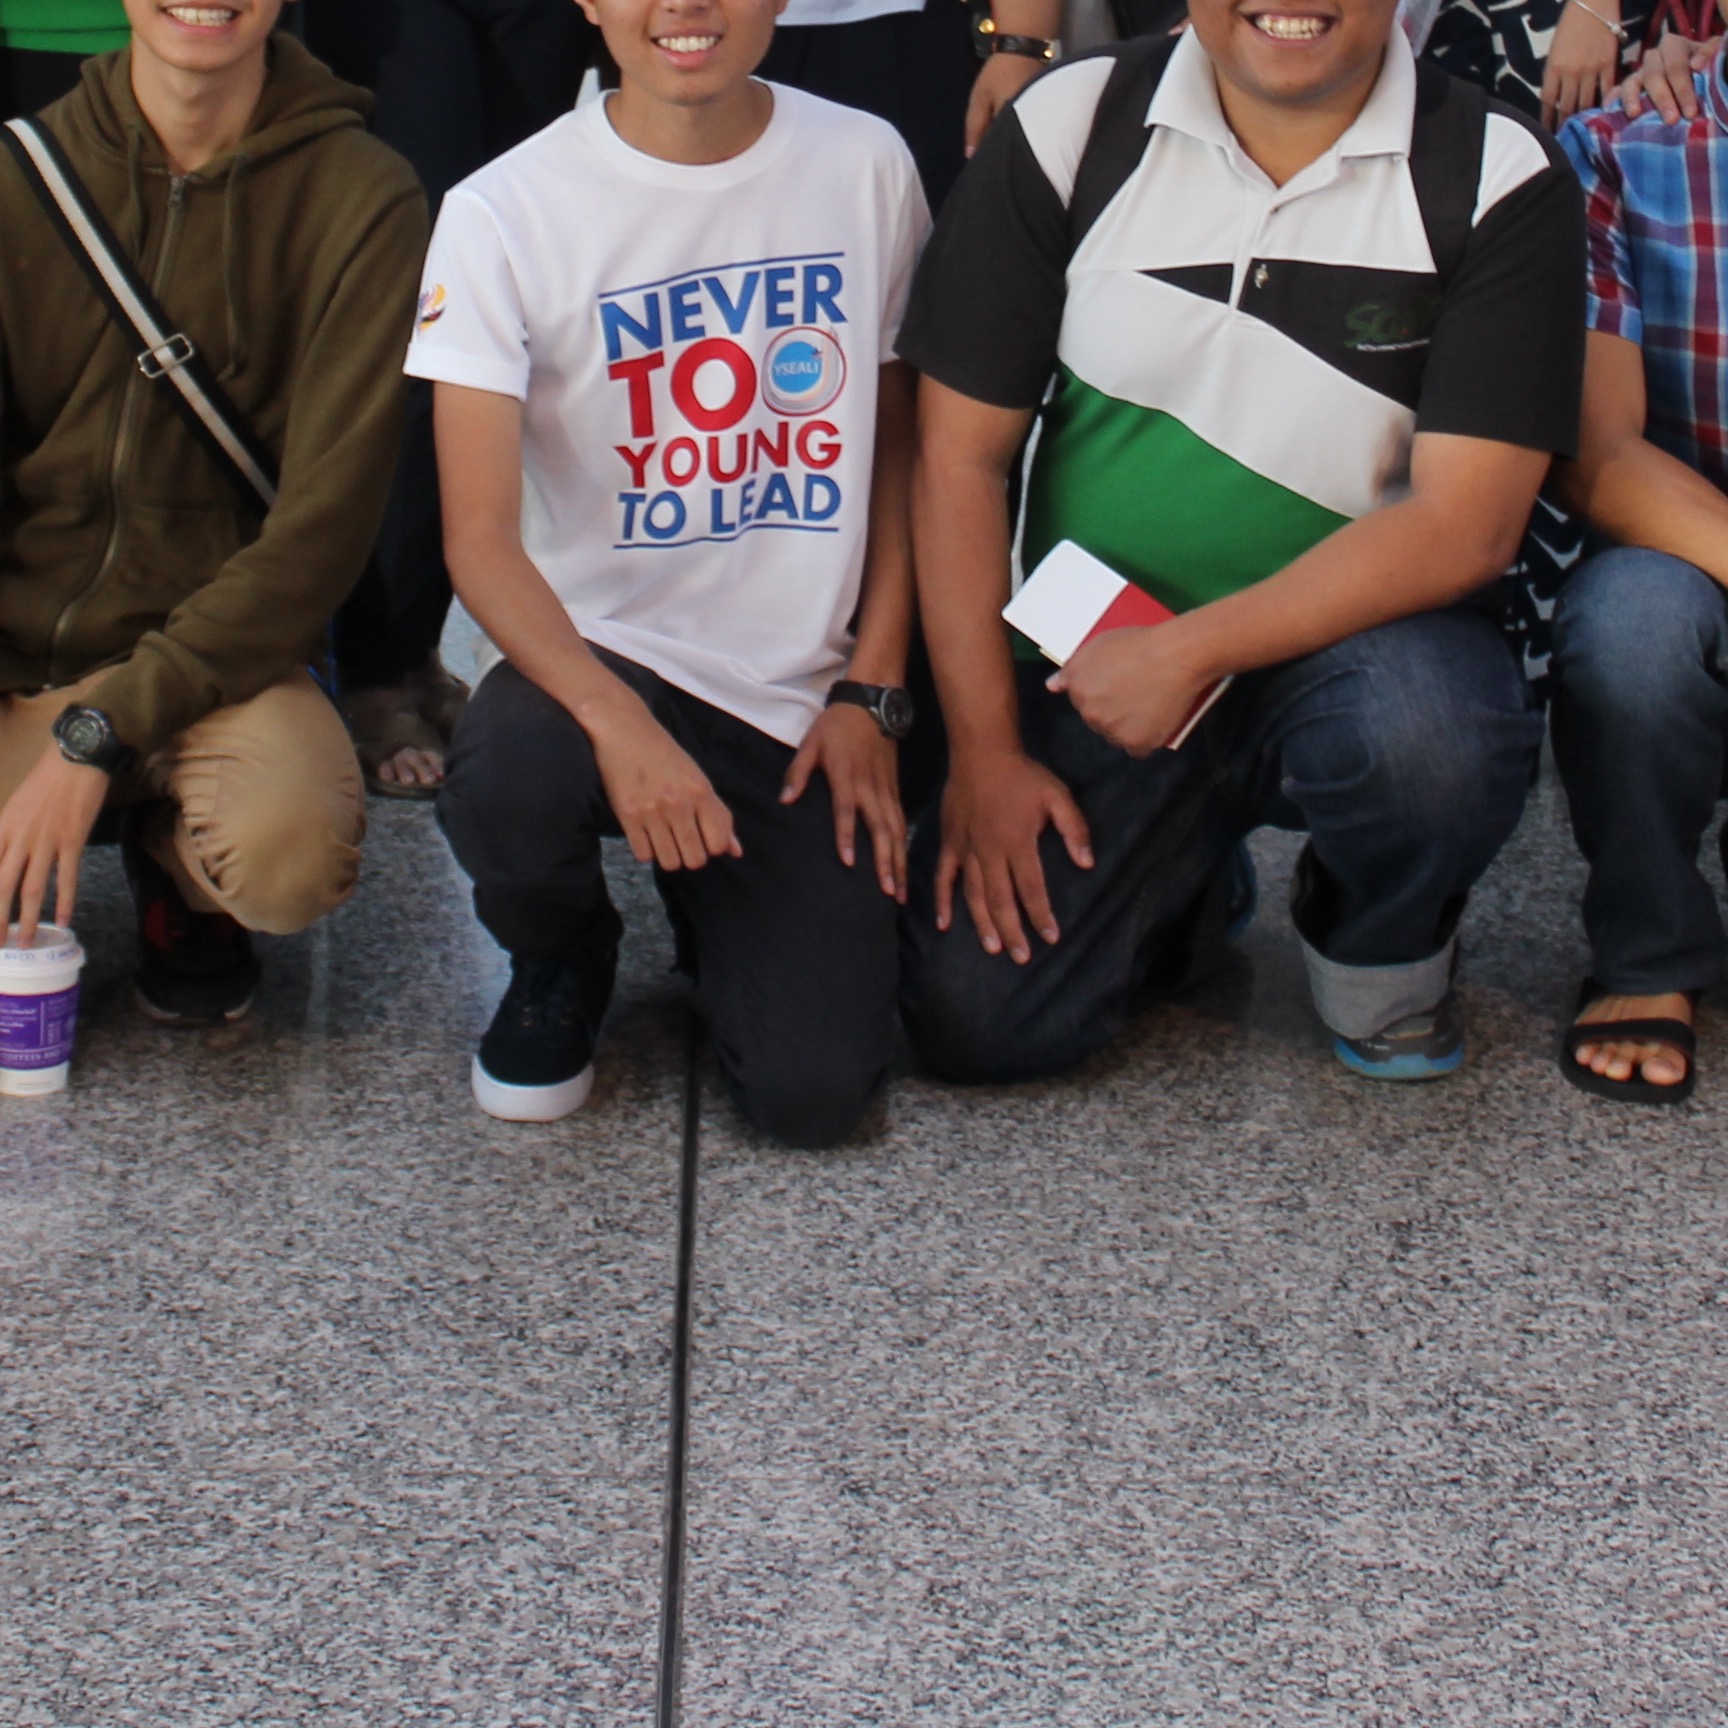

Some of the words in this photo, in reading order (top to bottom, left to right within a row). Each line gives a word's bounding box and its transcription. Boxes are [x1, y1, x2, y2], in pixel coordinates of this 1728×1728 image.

[598, 264, 848, 361] NEVER
[773, 360, 820, 377] YSEALI
[613, 419, 843, 489] YOUNG
[618, 491, 687, 541] TO
[710, 473, 842, 535] LEAD
